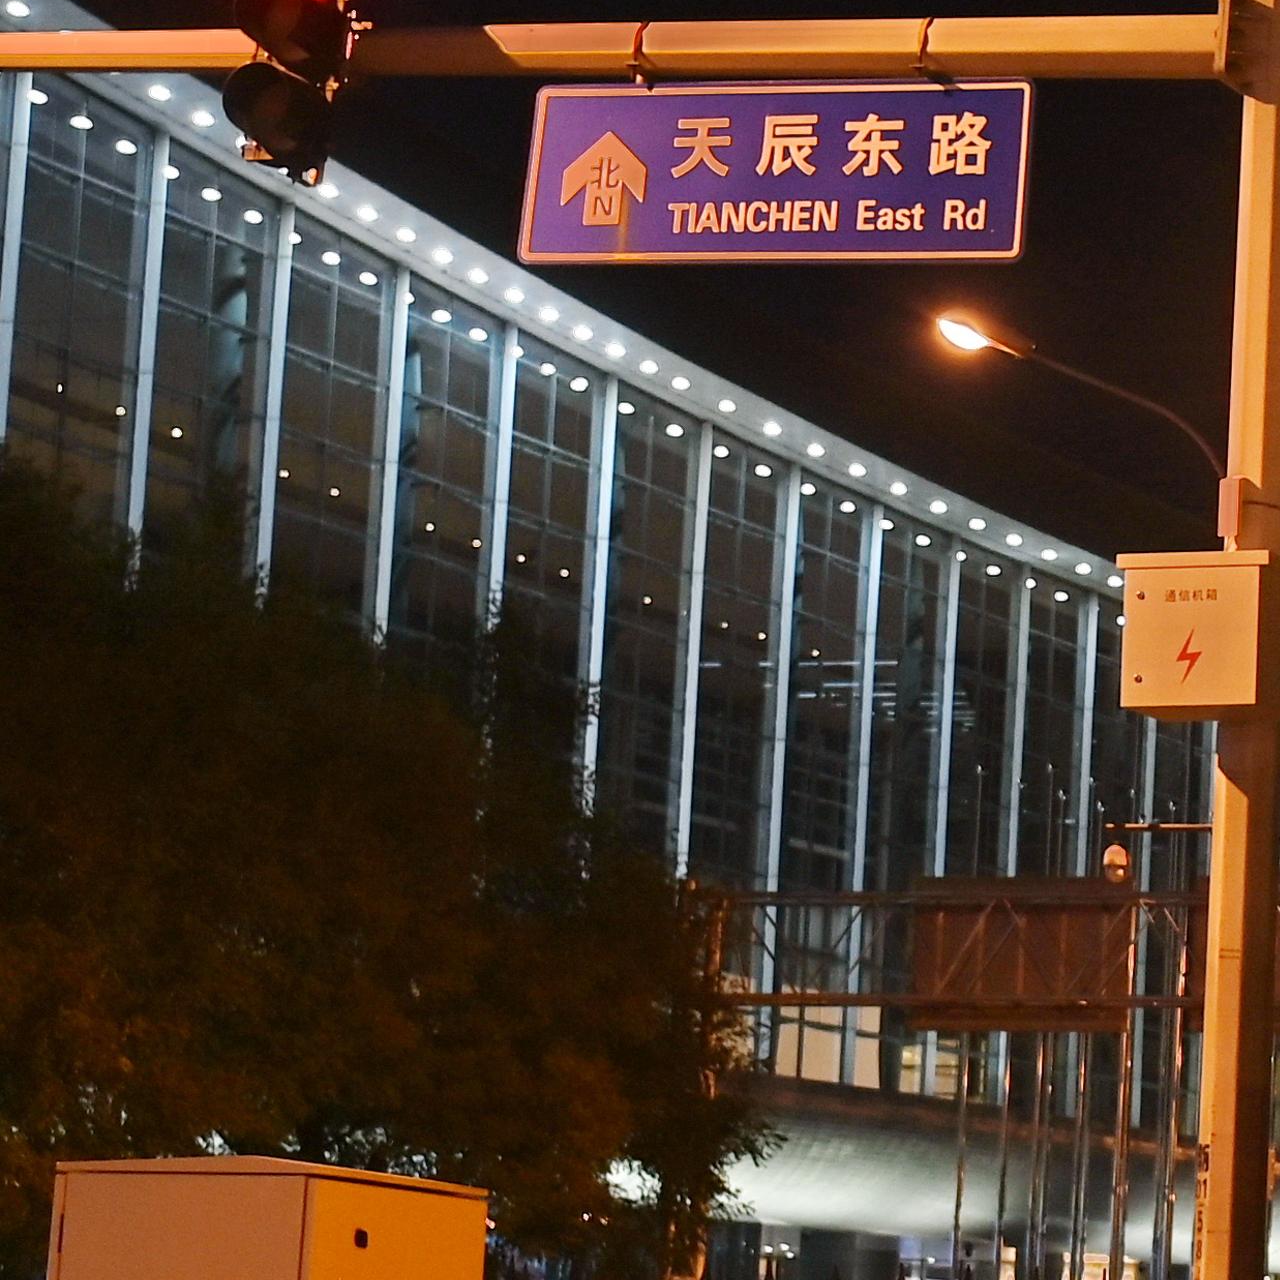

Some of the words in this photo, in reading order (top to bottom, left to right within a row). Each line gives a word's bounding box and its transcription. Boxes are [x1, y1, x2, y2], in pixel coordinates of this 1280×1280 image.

[670, 110, 992, 179] 天辰东路
[590, 157, 621, 189] 北
[592, 195, 613, 217] N
[668, 199, 838, 234] TIANCHEN
[856, 199, 925, 232] East
[943, 198, 987, 232] Rd
[1164, 588, 1218, 603] 通信机箱
